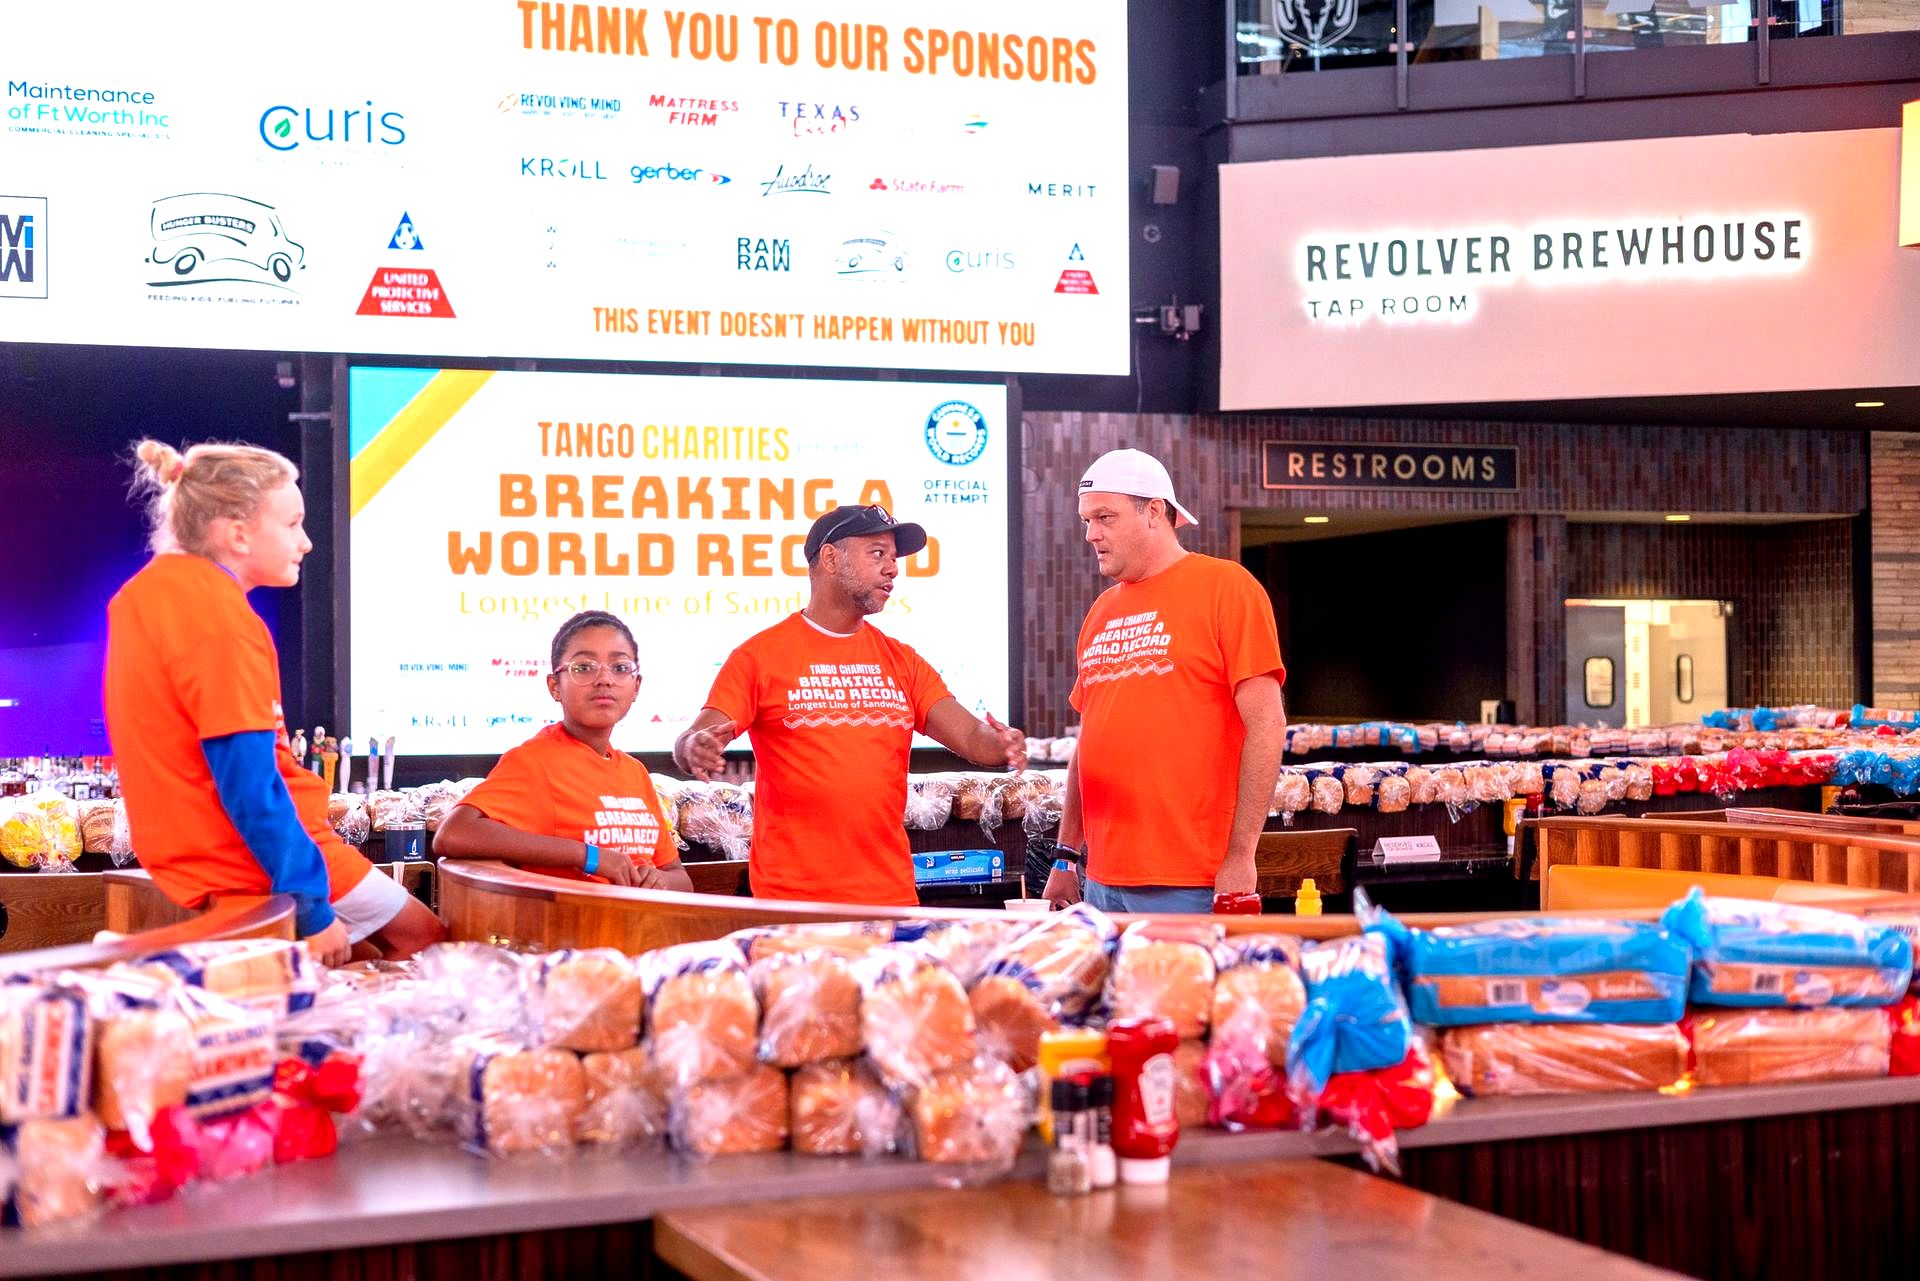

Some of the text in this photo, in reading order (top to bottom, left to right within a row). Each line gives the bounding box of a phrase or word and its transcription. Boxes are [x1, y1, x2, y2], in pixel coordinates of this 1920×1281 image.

[517, 0, 1097, 85] THANK YOU TO OUR SPONSORS
[8, 80, 155, 105] Maintenance
[521, 94, 620, 112] REVOLVING MIND
[649, 95, 738, 111] MATTRESS
[779, 101, 860, 121] TEXAS
[8, 103, 169, 127] of Ft Worth Inc
[669, 112, 718, 126] FIRM
[70, 129, 113, 137] CLEANING
[259, 100, 406, 151] Curis
[630, 162, 703, 184] gerber
[1029, 182, 1097, 197] MERIT
[1307, 220, 1801, 282] REVOLVER BREWHOUSE
[737, 254, 790, 271] RAW
[1308, 294, 1467, 318] TAP ROOM
[593, 307, 1036, 347] THIS EVENT DOESN'T HAPPEN WITHOUT YOU
[538, 421, 789, 462] TANGO CHARITIES
[1288, 452, 1497, 481] RESTROOMS
[924, 479, 988, 491] OFFICIAL
[499, 473, 837, 520] BREAKING
[925, 493, 988, 505] ATTEMPT
[448, 531, 941, 578] WORLD RECD
[460, 590, 588, 621] Longest
[684, 590, 713, 614] of
[1092, 622, 1165, 645] BREAKING A
[1121, 634, 1171, 653] RECORD
[809, 664, 882, 675] TANGO CHARITIES
[799, 675, 885, 688] BREAKING
[788, 688, 847, 702] WORLD
[788, 701, 827, 711] Longest
[829, 701, 849, 709] Line
[850, 700, 861, 709] of
[584, 827, 660, 845] WORLD RECO
